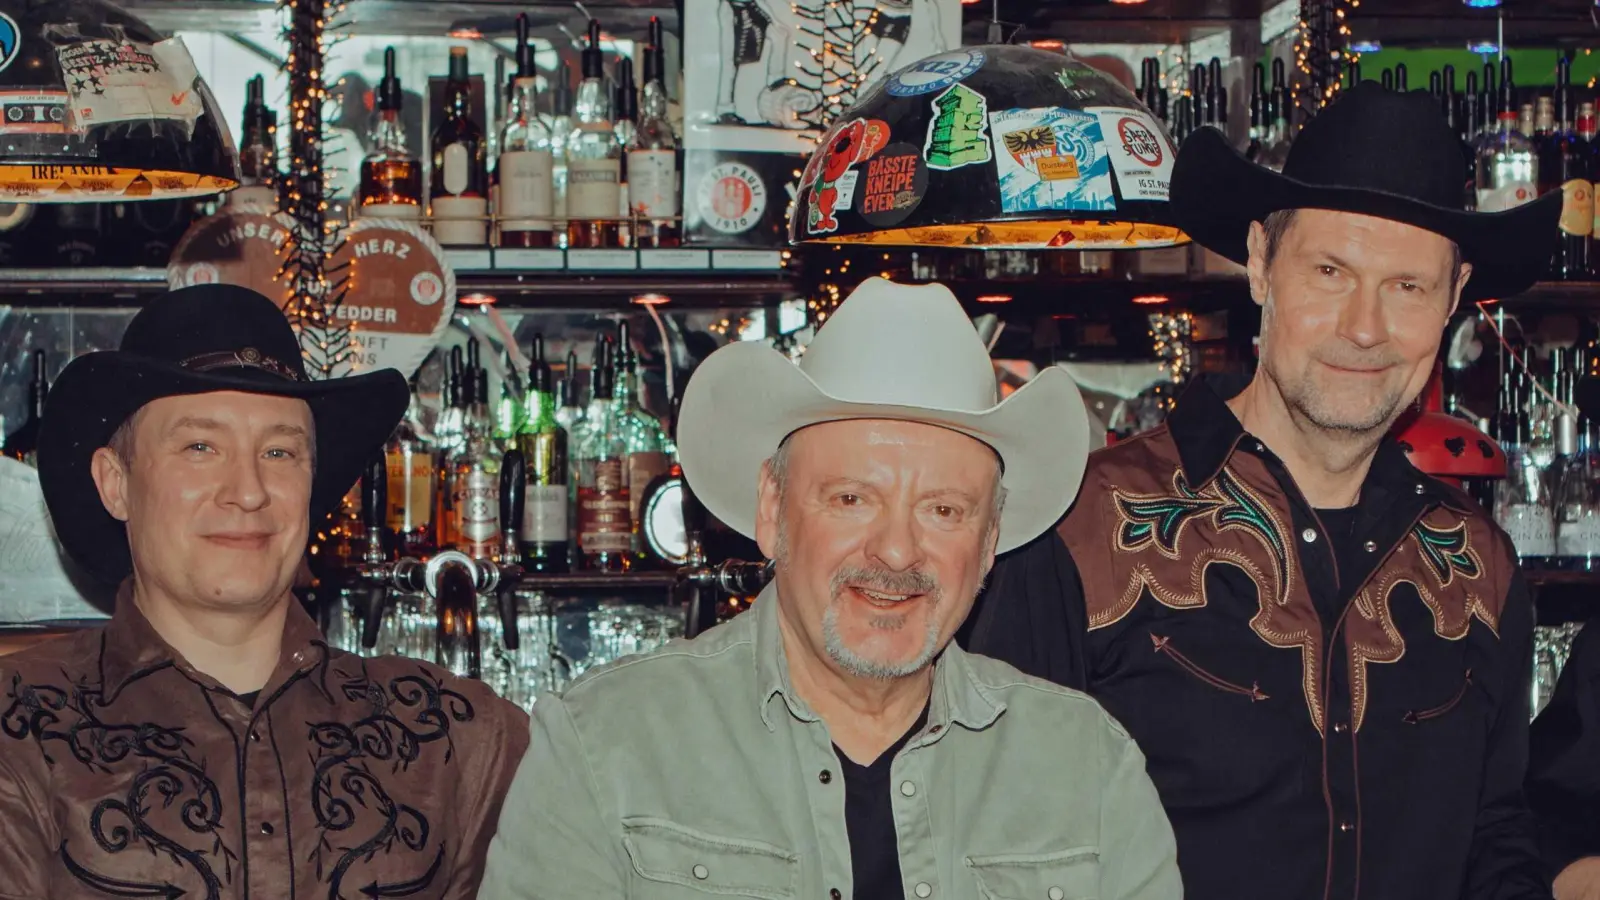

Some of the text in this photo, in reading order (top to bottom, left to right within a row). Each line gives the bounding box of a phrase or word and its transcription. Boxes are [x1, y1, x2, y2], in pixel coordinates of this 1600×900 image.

[732, 166, 763, 197] PAULI
[865, 172, 917, 196] KNEIPE
[864, 194, 896, 214] EVER
[715, 216, 748, 230] 1910
[216, 221, 286, 249] UNSER
[354, 239, 412, 260] HERZ
